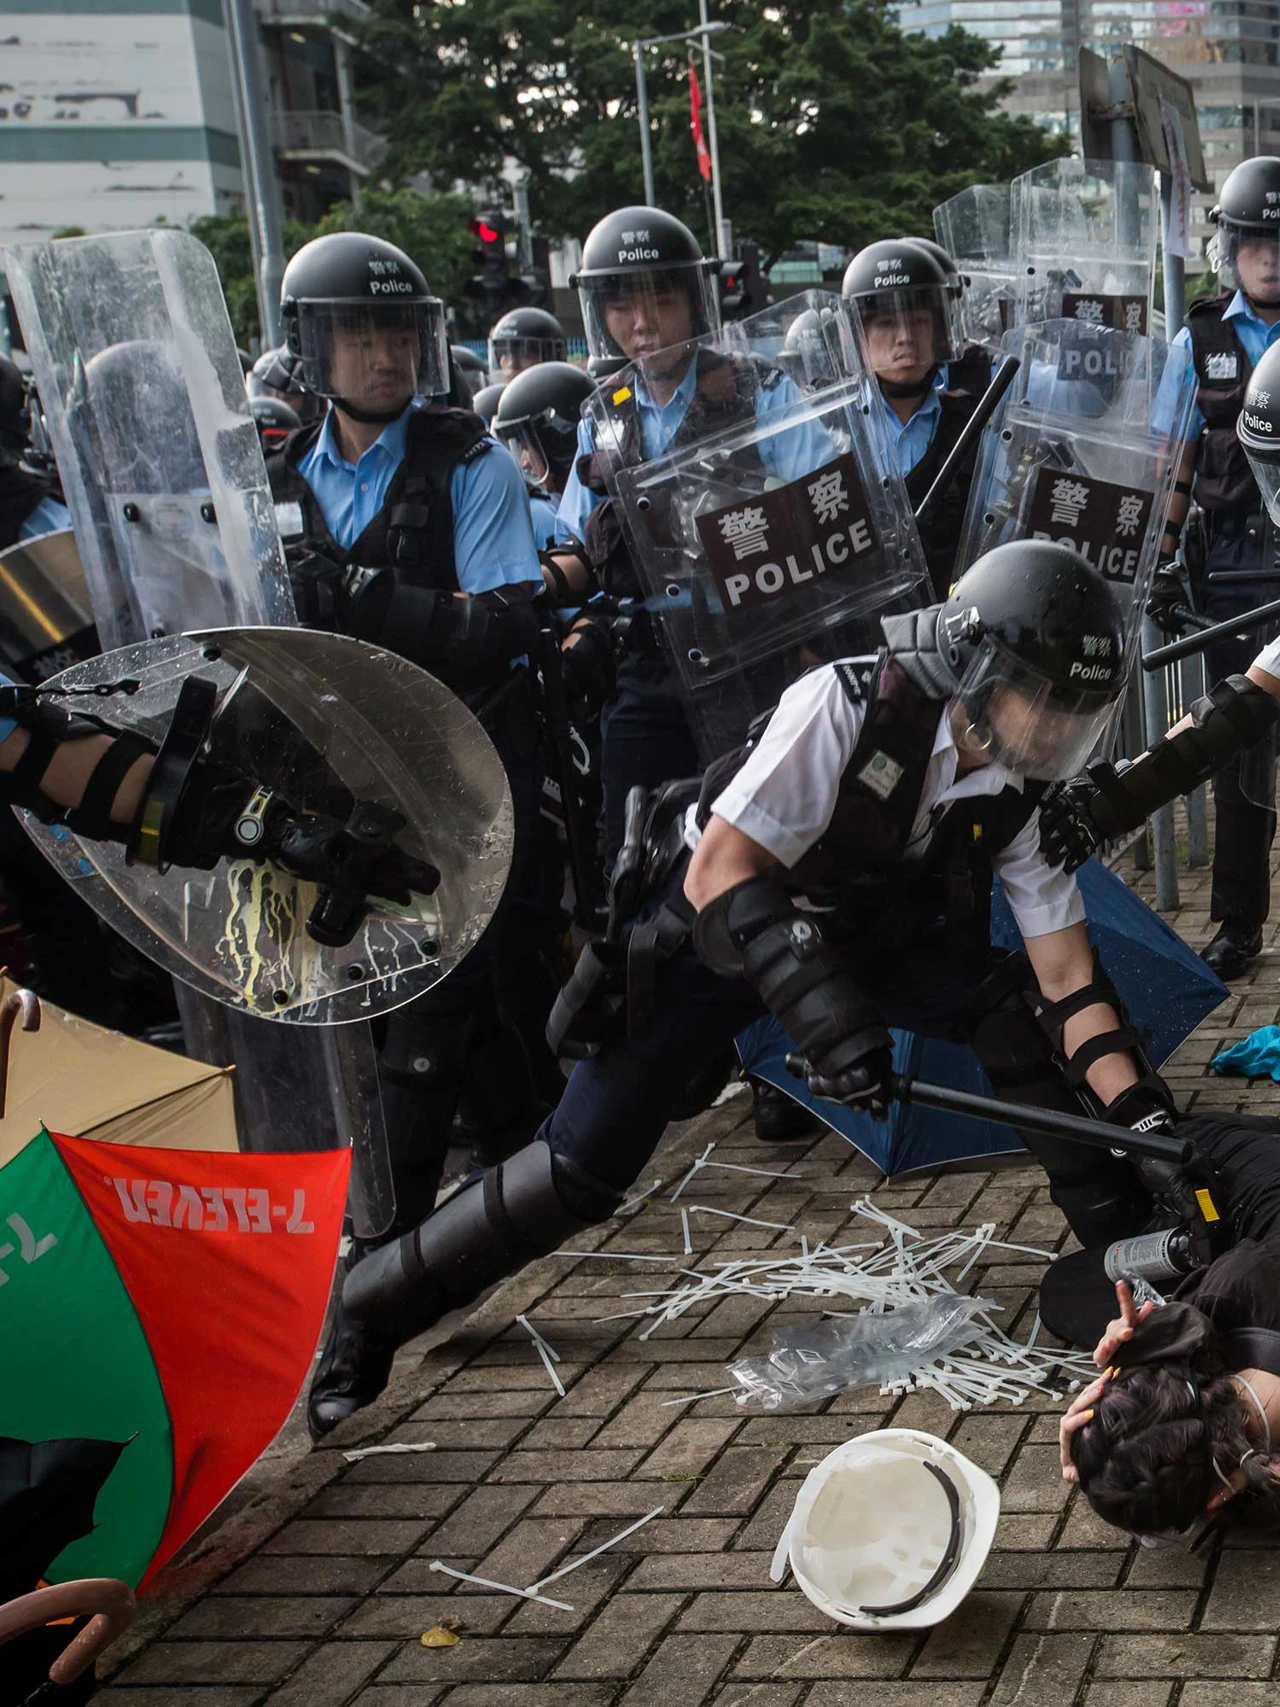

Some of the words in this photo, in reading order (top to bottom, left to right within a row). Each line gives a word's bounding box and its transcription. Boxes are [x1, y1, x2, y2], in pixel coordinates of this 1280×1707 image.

[618, 247, 660, 263] Police
[370, 279, 413, 295] Police
[874, 273, 911, 289] Police
[1245, 411, 1273, 432] Police
[717, 470, 850, 561] 警察
[1050, 479, 1144, 537] 警察
[724, 518, 873, 608] POLICE
[1069, 661, 1112, 680] Police
